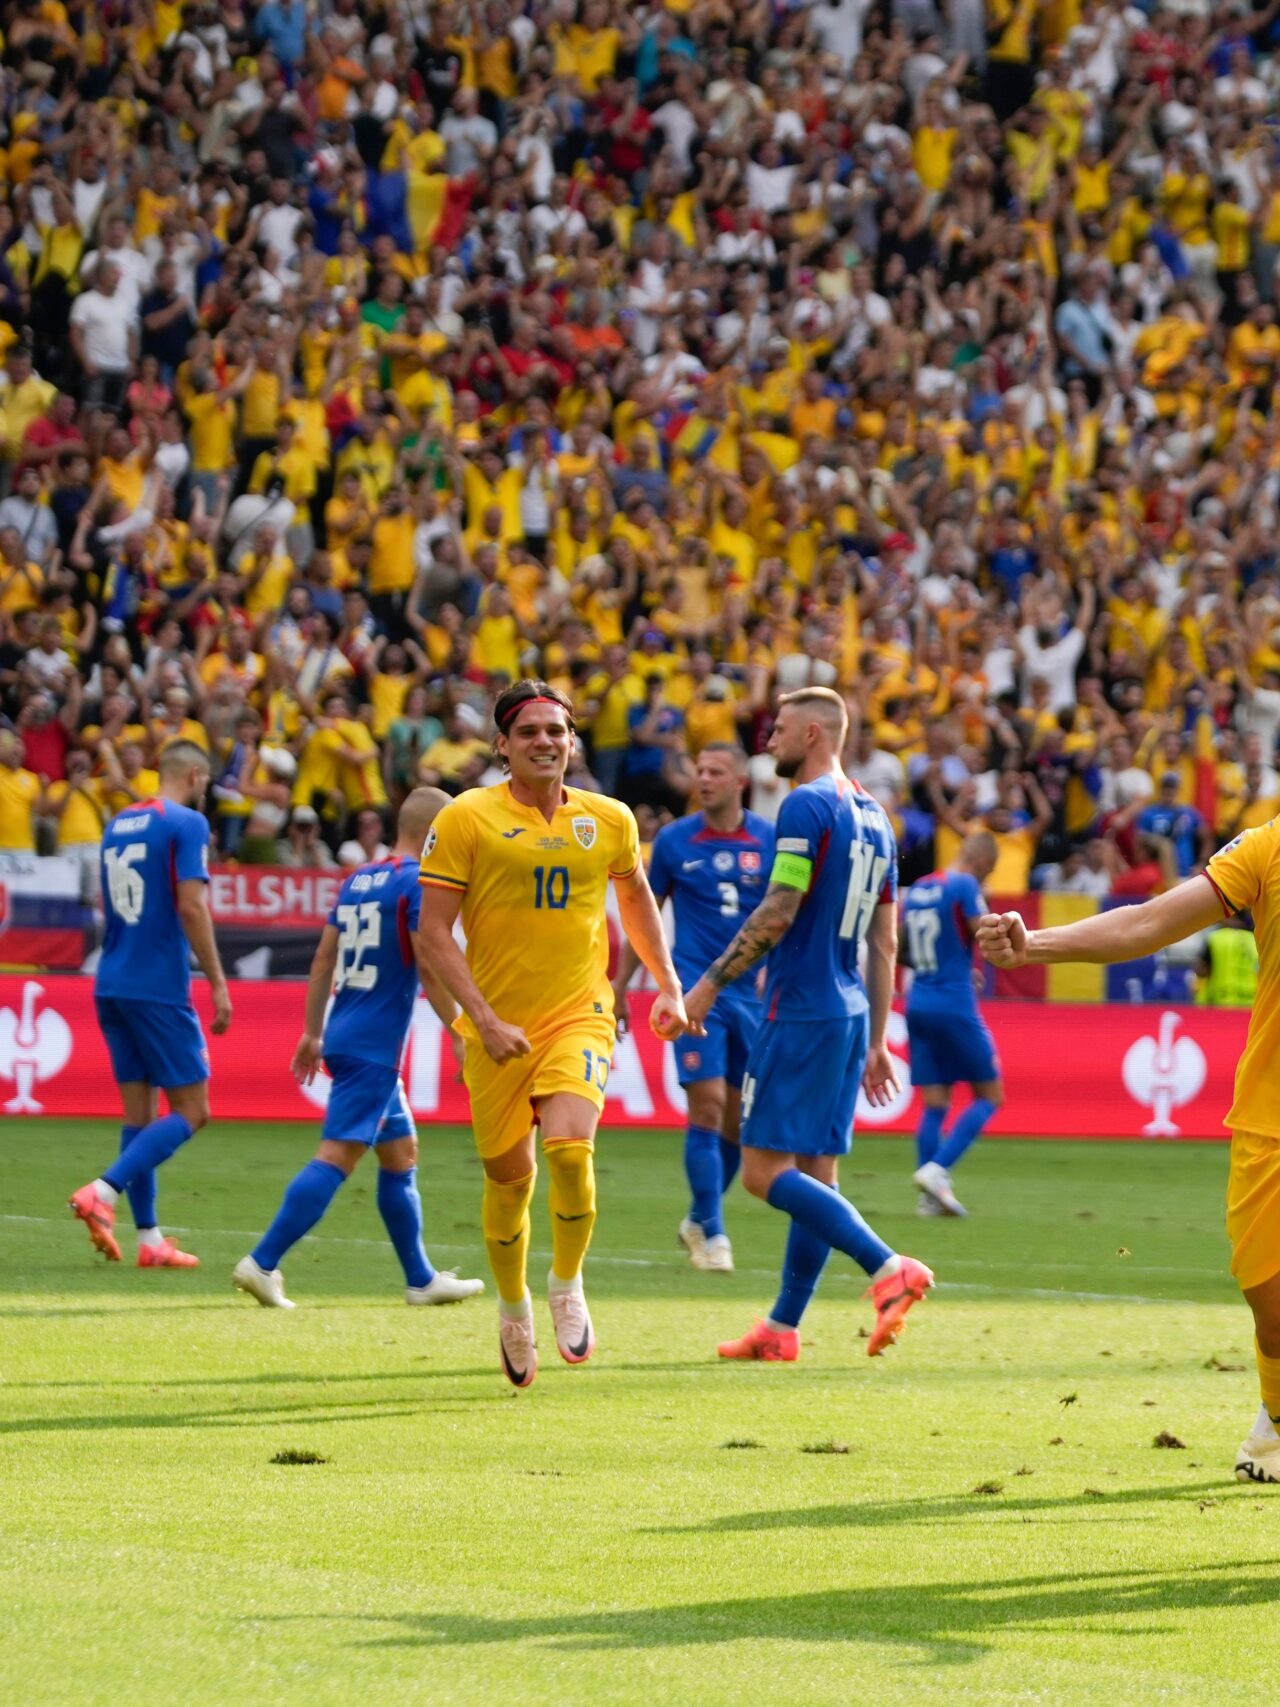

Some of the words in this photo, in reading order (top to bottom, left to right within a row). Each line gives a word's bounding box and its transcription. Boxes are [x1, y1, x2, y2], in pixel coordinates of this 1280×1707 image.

[104, 843, 146, 925] 16
[207, 873, 341, 916] ELSHE
[533, 866, 570, 909] 10
[718, 882, 739, 917] 3
[335, 901, 382, 993] 22
[582, 1048, 609, 1093] 10
